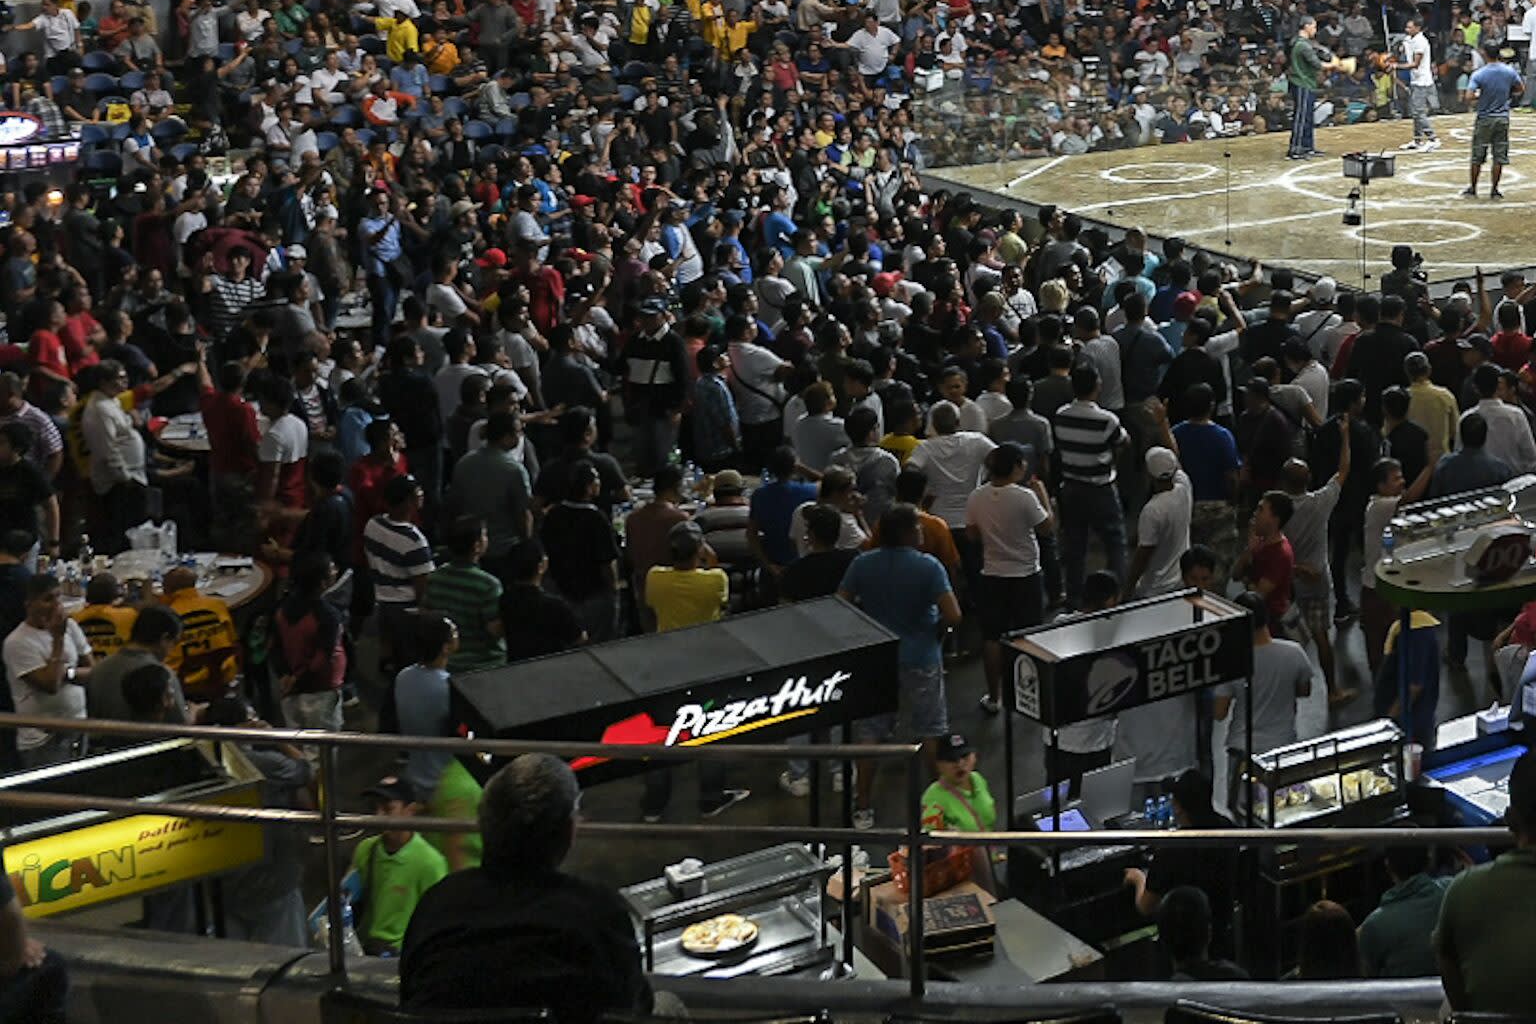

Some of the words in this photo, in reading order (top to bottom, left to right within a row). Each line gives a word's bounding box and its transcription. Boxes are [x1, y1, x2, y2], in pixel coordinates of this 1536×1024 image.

[1142, 628, 1222, 670] TACO
[1147, 658, 1221, 698] BELL
[663, 698, 768, 748] Pizza
[769, 672, 852, 711] Hut
